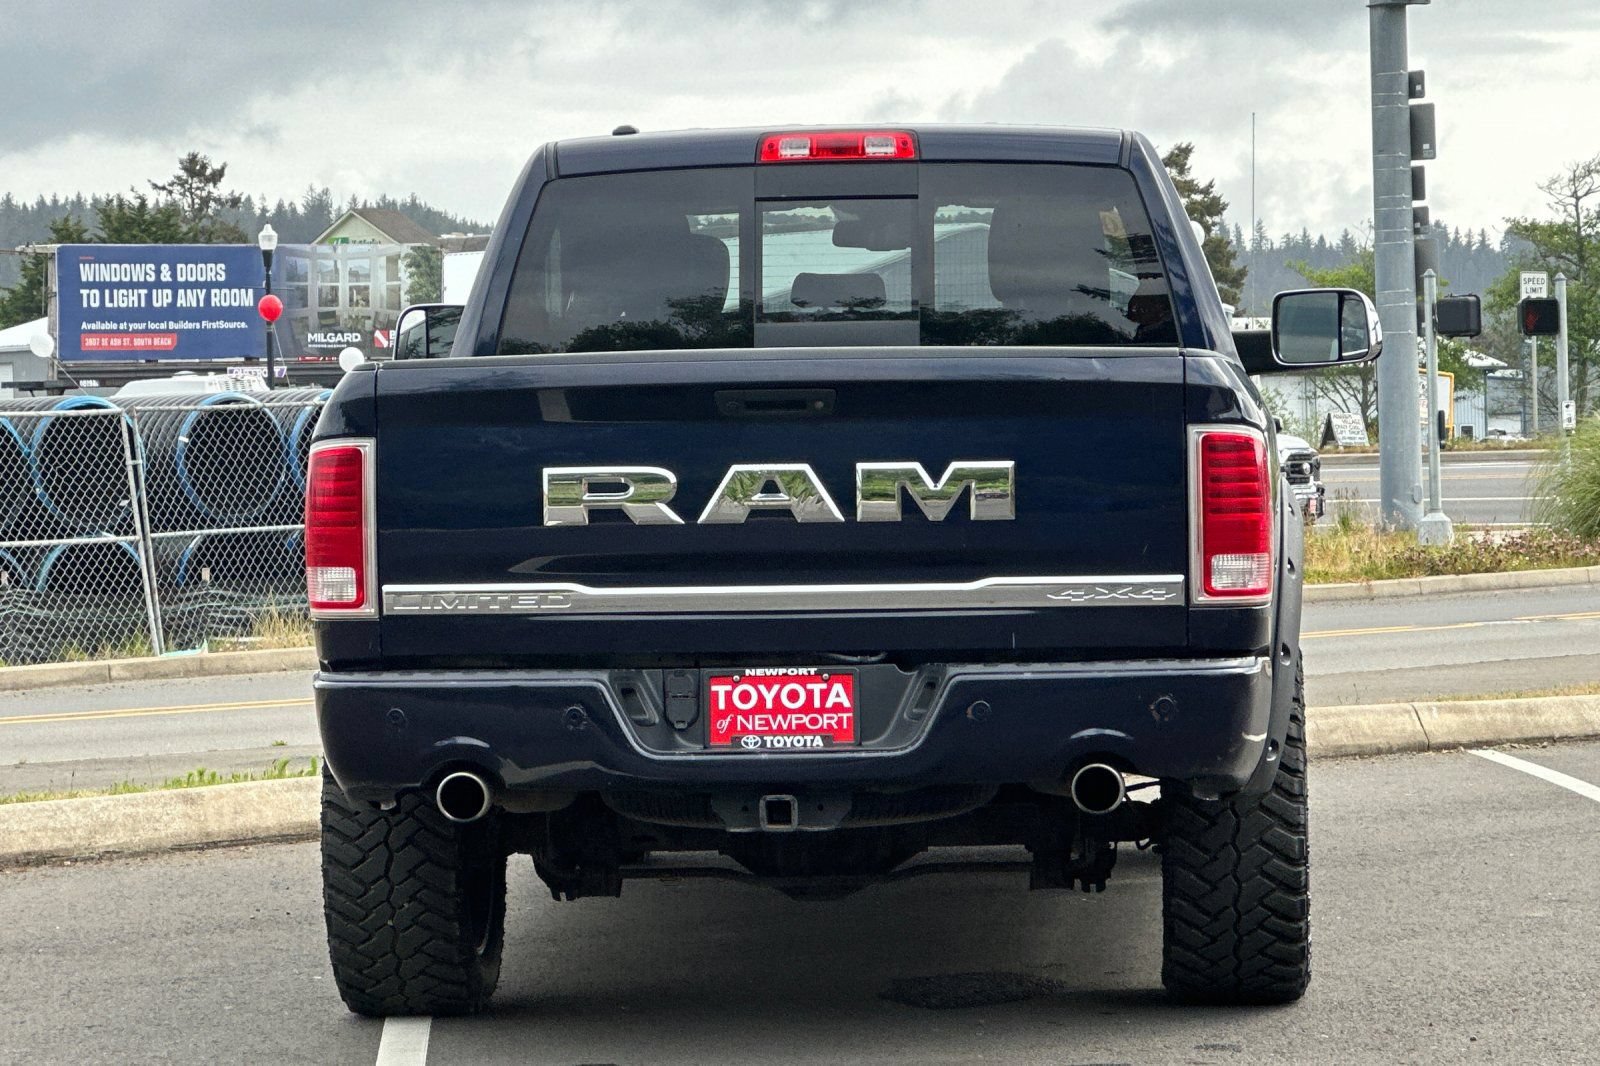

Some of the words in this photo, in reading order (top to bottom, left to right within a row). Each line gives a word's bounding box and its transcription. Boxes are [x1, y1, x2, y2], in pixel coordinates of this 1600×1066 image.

[79, 263, 155, 282] WINDOWS
[160, 263, 173, 282] &
[176, 263, 226, 282] DOORS
[1523, 277, 1546, 285] SPEED
[1525, 286, 1543, 294] LIMIT
[80, 289, 100, 308] TO
[104, 289, 148, 308] LIGHT
[152, 289, 172, 308] UP
[176, 289, 206, 308] ANY
[211, 288, 254, 307] ROOM
[81, 321, 117, 330] Available
[119, 322, 128, 330] at
[128, 322, 147, 332] your
[148, 321, 167, 329] local
[169, 320, 200, 329] Builders
[202, 320, 248, 329] FirstSource.
[133, 337, 151, 346] SOUTH
[153, 337, 172, 346] BEACH
[307, 333, 361, 342] MILGARD
[542, 461, 1015, 526] RAM
[393, 595, 571, 609] LIMITED
[744, 667, 818, 677] NEWPORT
[711, 683, 852, 710] TOYOTA
[716, 714, 734, 733] of
[737, 713, 853, 731] NEWPORT
[763, 735, 824, 748] TOYOTA
